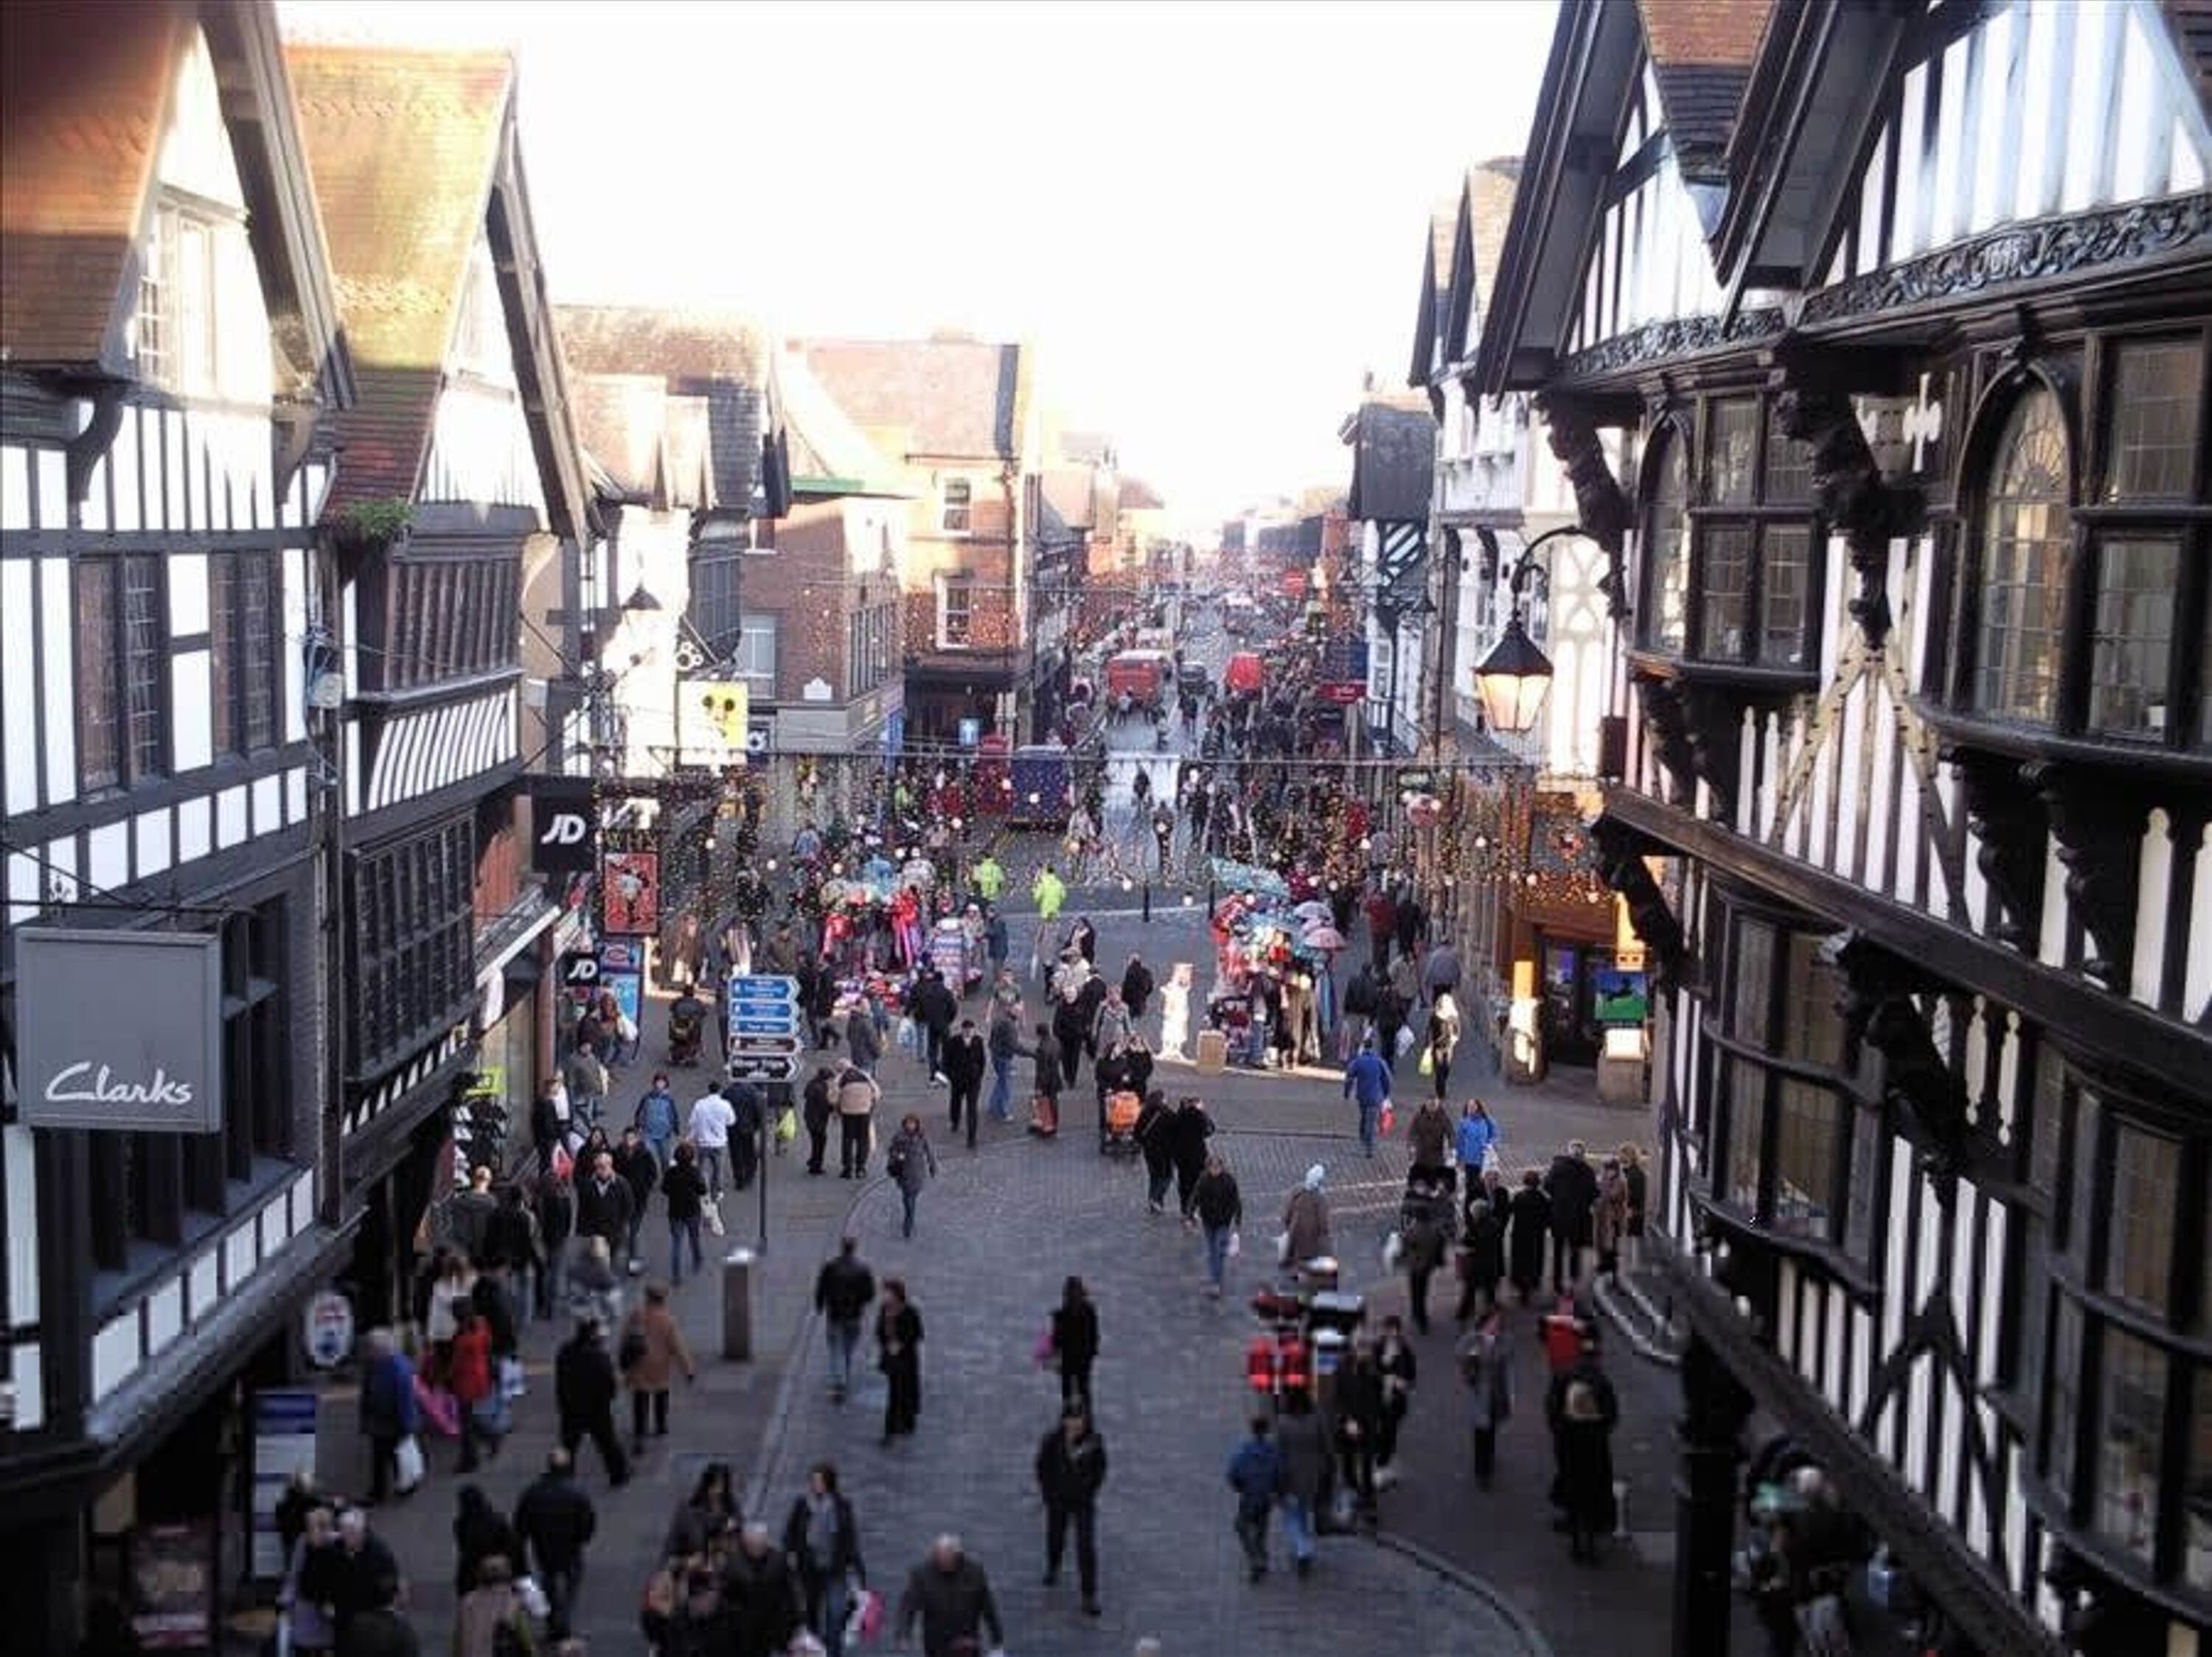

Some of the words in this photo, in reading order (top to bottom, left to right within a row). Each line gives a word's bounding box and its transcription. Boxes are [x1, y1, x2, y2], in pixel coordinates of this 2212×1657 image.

[540, 814, 586, 844] JD
[567, 959, 597, 979] JD
[44, 1061, 192, 1104] Clarks
